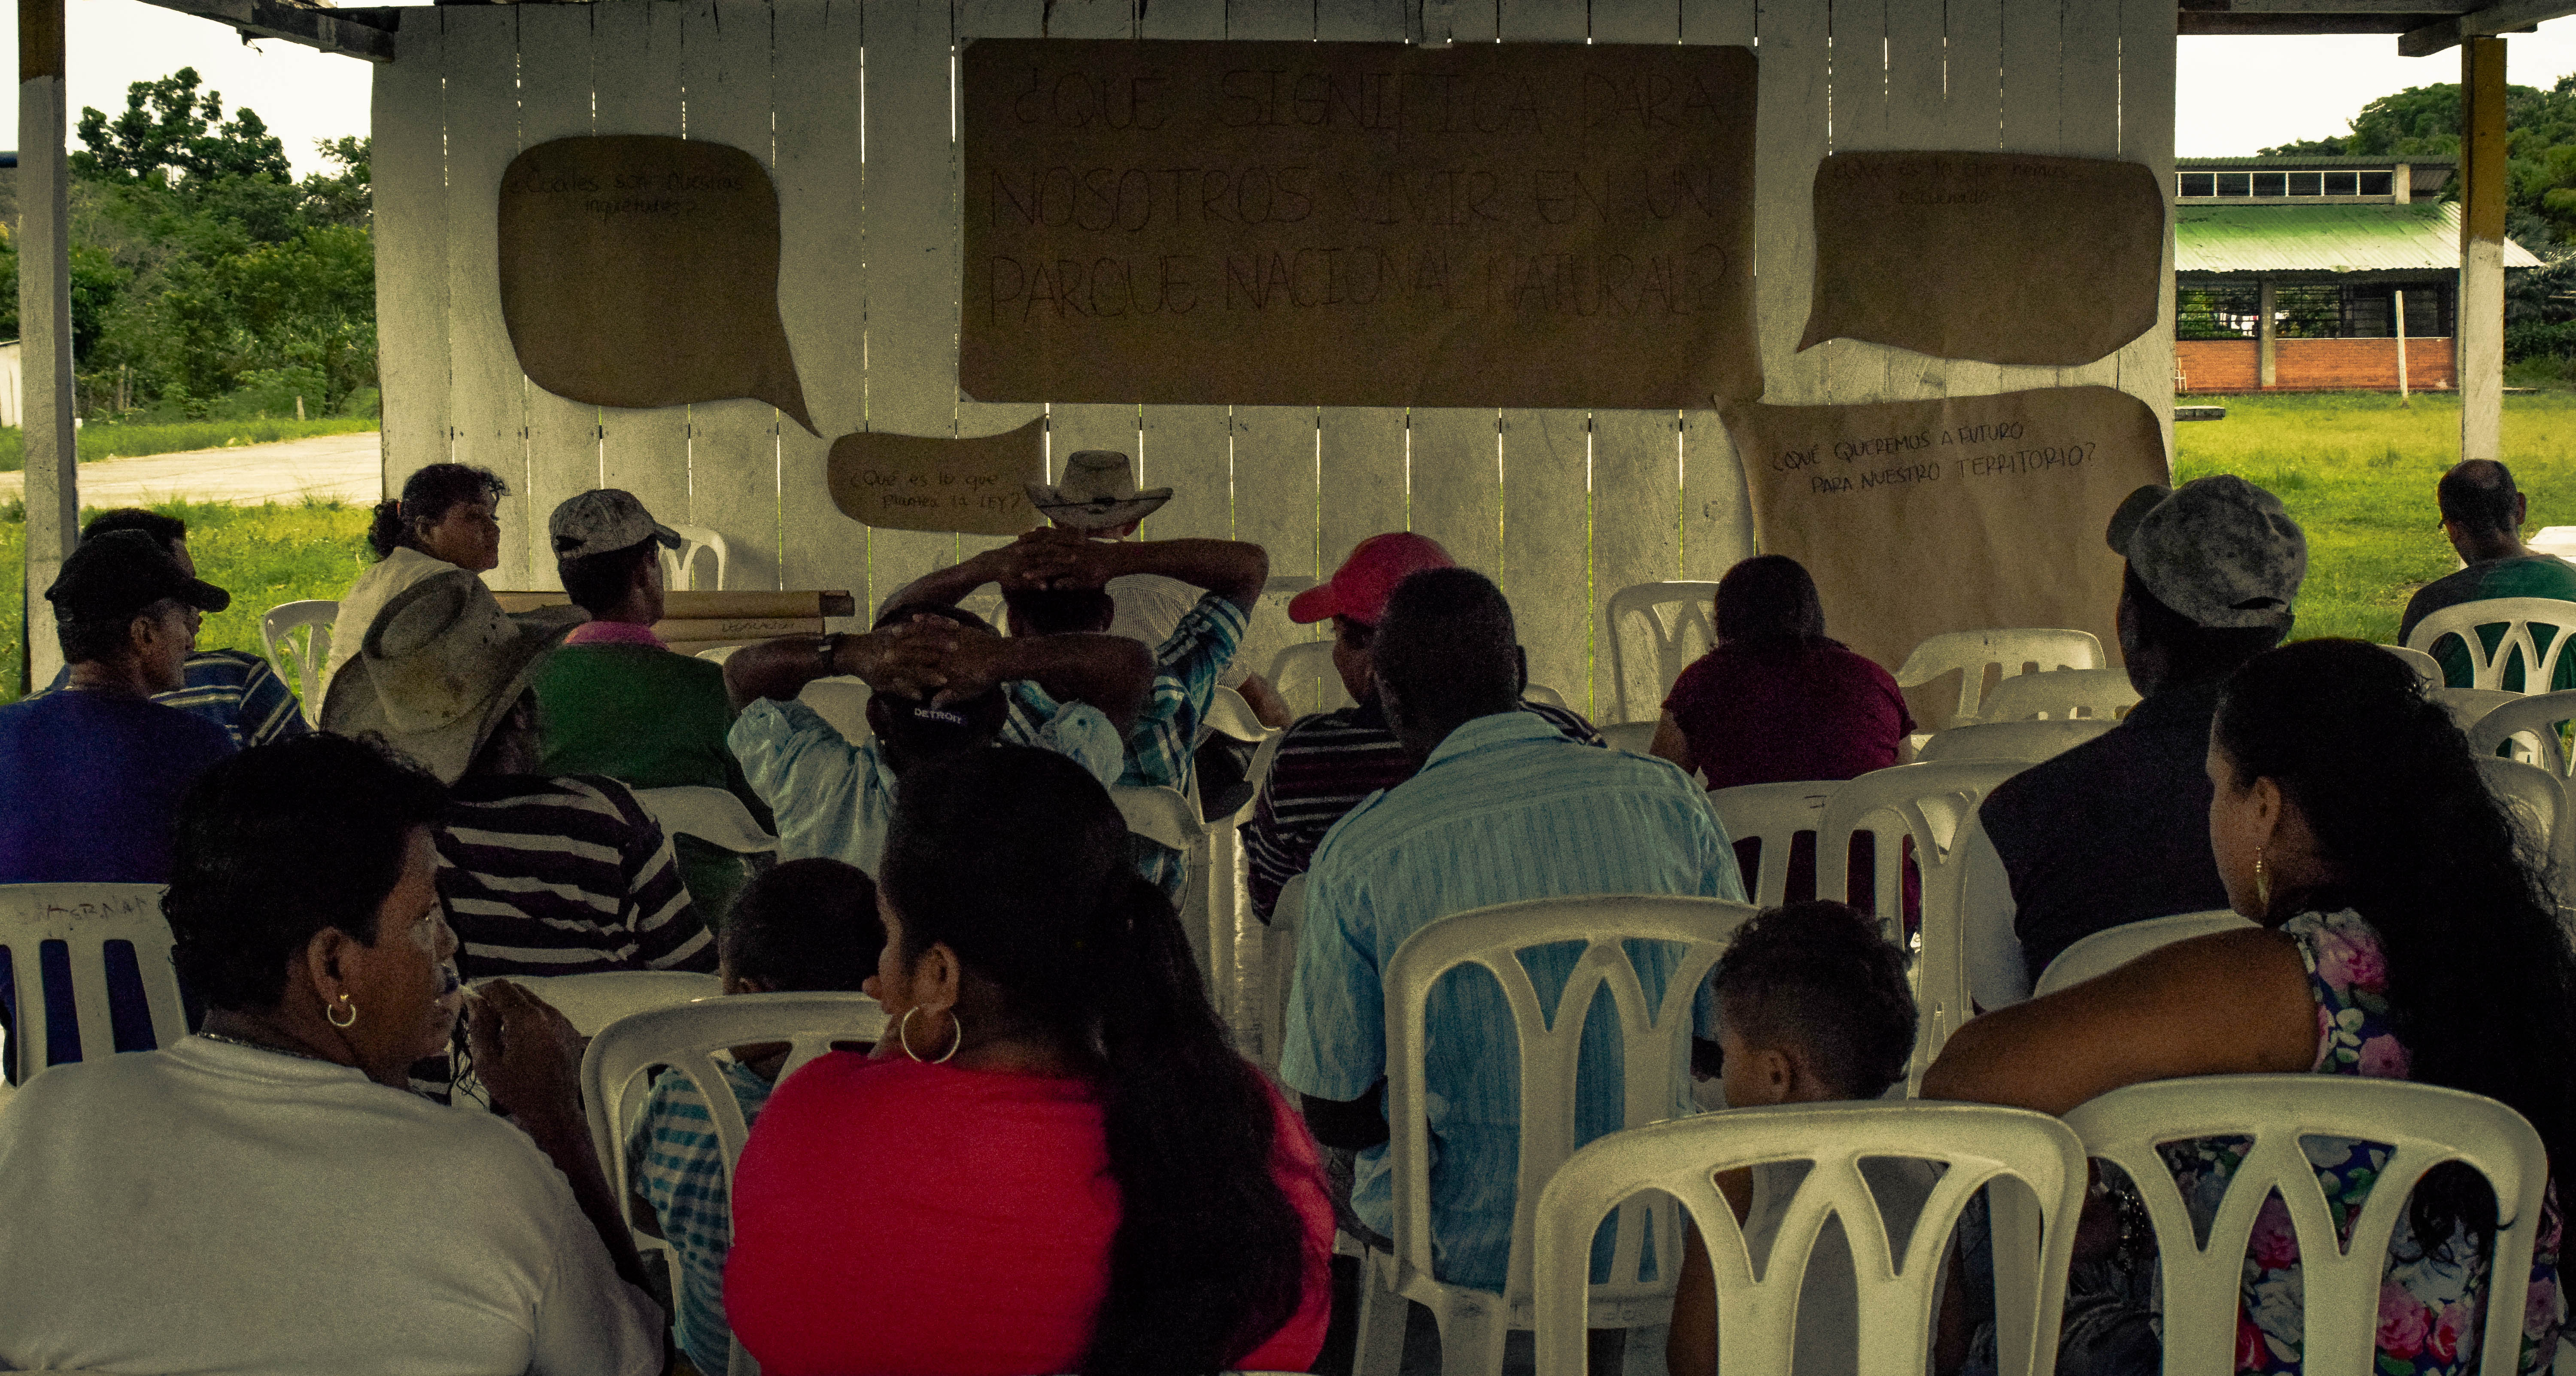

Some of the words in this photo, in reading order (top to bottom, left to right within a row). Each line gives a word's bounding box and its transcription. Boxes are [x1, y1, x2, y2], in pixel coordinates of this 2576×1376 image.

[1218, 68, 1543, 152] SIGNIFICA
[1580, 70, 1723, 158] PARA
[989, 164, 1314, 232] NOSOTROS
[1337, 169, 1500, 226] VIVIR
[1534, 169, 1613, 225] EN
[1643, 169, 1714, 221] UN
[988, 252, 1198, 326] PARQUE
[1224, 246, 1469, 312] NACIONAL
[1485, 242, 1729, 317] NATURAL?
[1773, 444, 1819, 471] ¿QUÉ
[1834, 431, 1930, 463] QUEREMOS
[1941, 431, 1953, 446] A
[1958, 422, 2024, 442] FUTURO
[1811, 475, 1852, 493] PARA
[1861, 462, 1941, 487] NUESTRO
[1956, 441, 2096, 478] TERRITORIO?
[910, 475, 928, 486] es
[939, 471, 956, 486] lo
[965, 475, 999, 491] que
[951, 495, 968, 507] la
[914, 707, 963, 725] DETROIT
